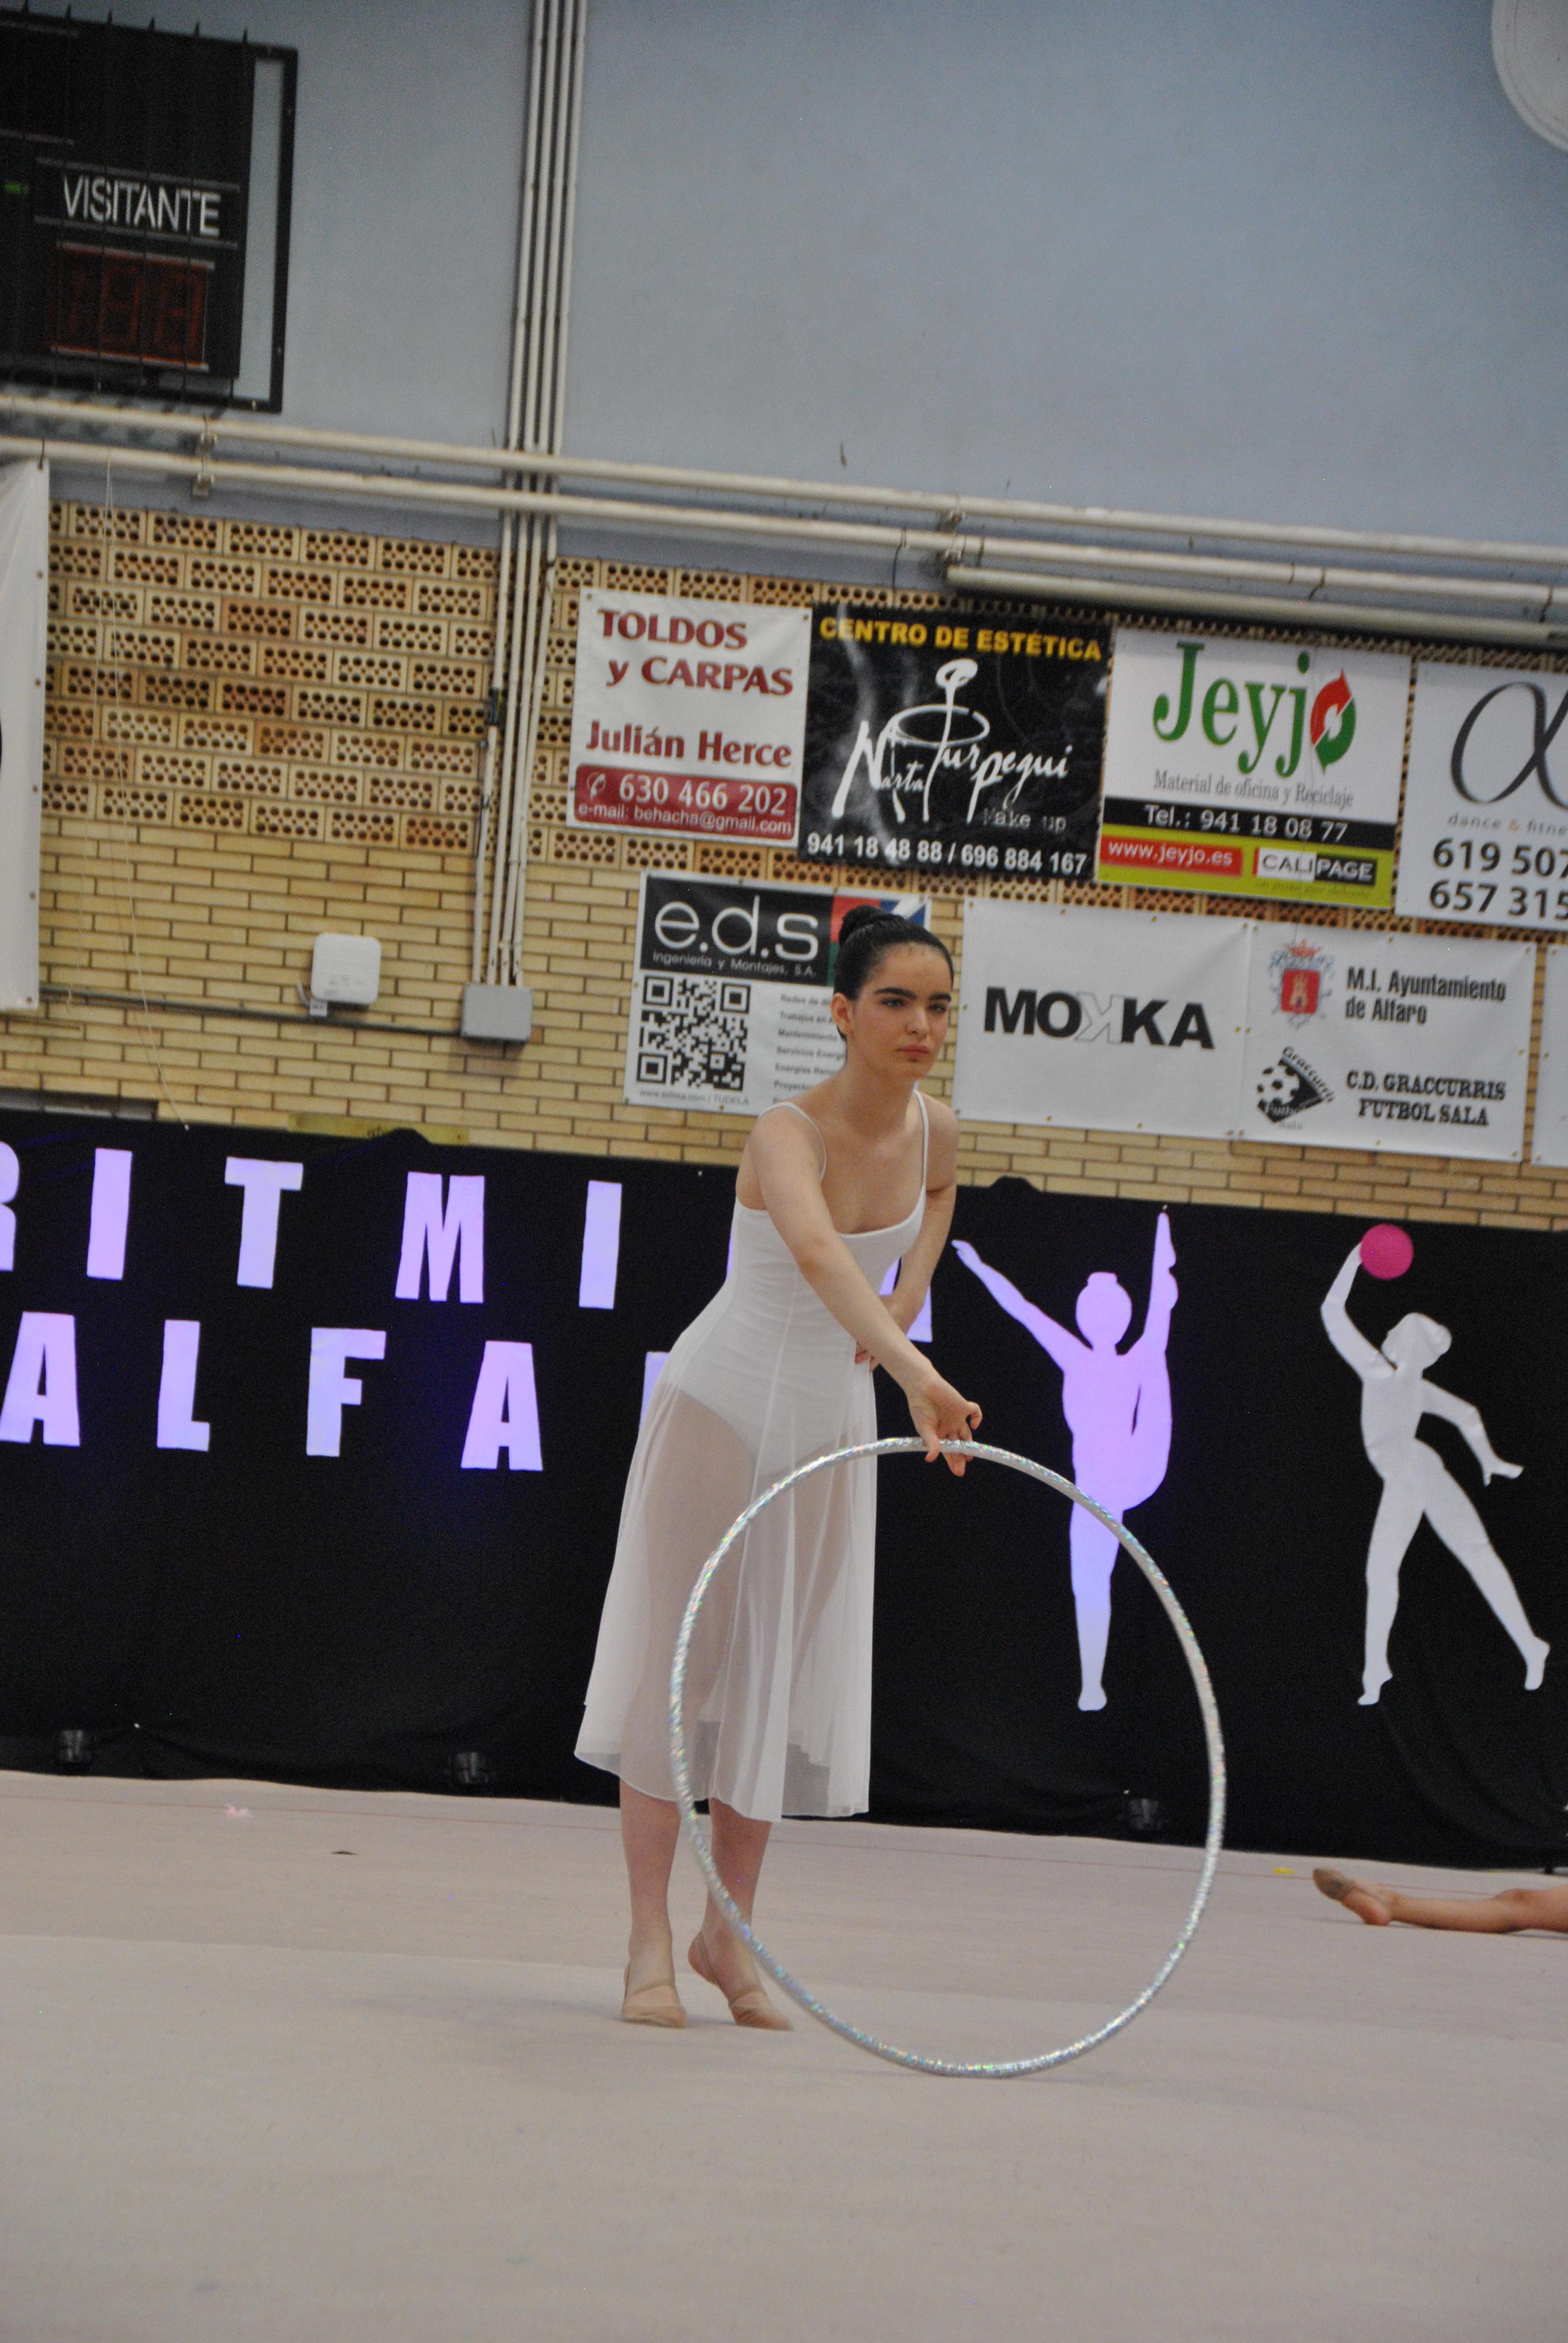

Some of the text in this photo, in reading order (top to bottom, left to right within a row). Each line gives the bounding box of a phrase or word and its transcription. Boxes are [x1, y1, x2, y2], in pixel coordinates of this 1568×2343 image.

[64, 174, 221, 237] VISITANTE
[597, 608, 748, 650] TOLDOS
[820, 617, 927, 646] CENTRO
[935, 626, 969, 649] DE
[606, 656, 794, 695] y CARPAS
[1153, 641, 1356, 778] Jeyjo
[586, 720, 792, 767] Julián Herce
[619, 774, 786, 816] 630 466 202
[1153, 769, 1354, 808] Material de oficina y Reciclaje
[578, 803, 791, 835] e-mail: behacha@gmail.com
[1145, 804, 1348, 842] Tel.: 941 18 08 77
[1448, 813, 1502, 830] dance
[807, 831, 1088, 875] 941 18 48 88 / 696 884 167
[1108, 841, 1233, 867] www.jeyjo.es
[1433, 837, 1501, 871] 619
[1429, 880, 1498, 913] 657
[718, 958, 725, 970] y
[1346, 967, 1506, 1002] M.I. Ayuntamiento
[1345, 997, 1427, 1024] de Alfaro
[1347, 1071, 1506, 1101] C.D. GRACCURRIS
[1359, 1098, 1489, 1127] FUTBOL SALA
